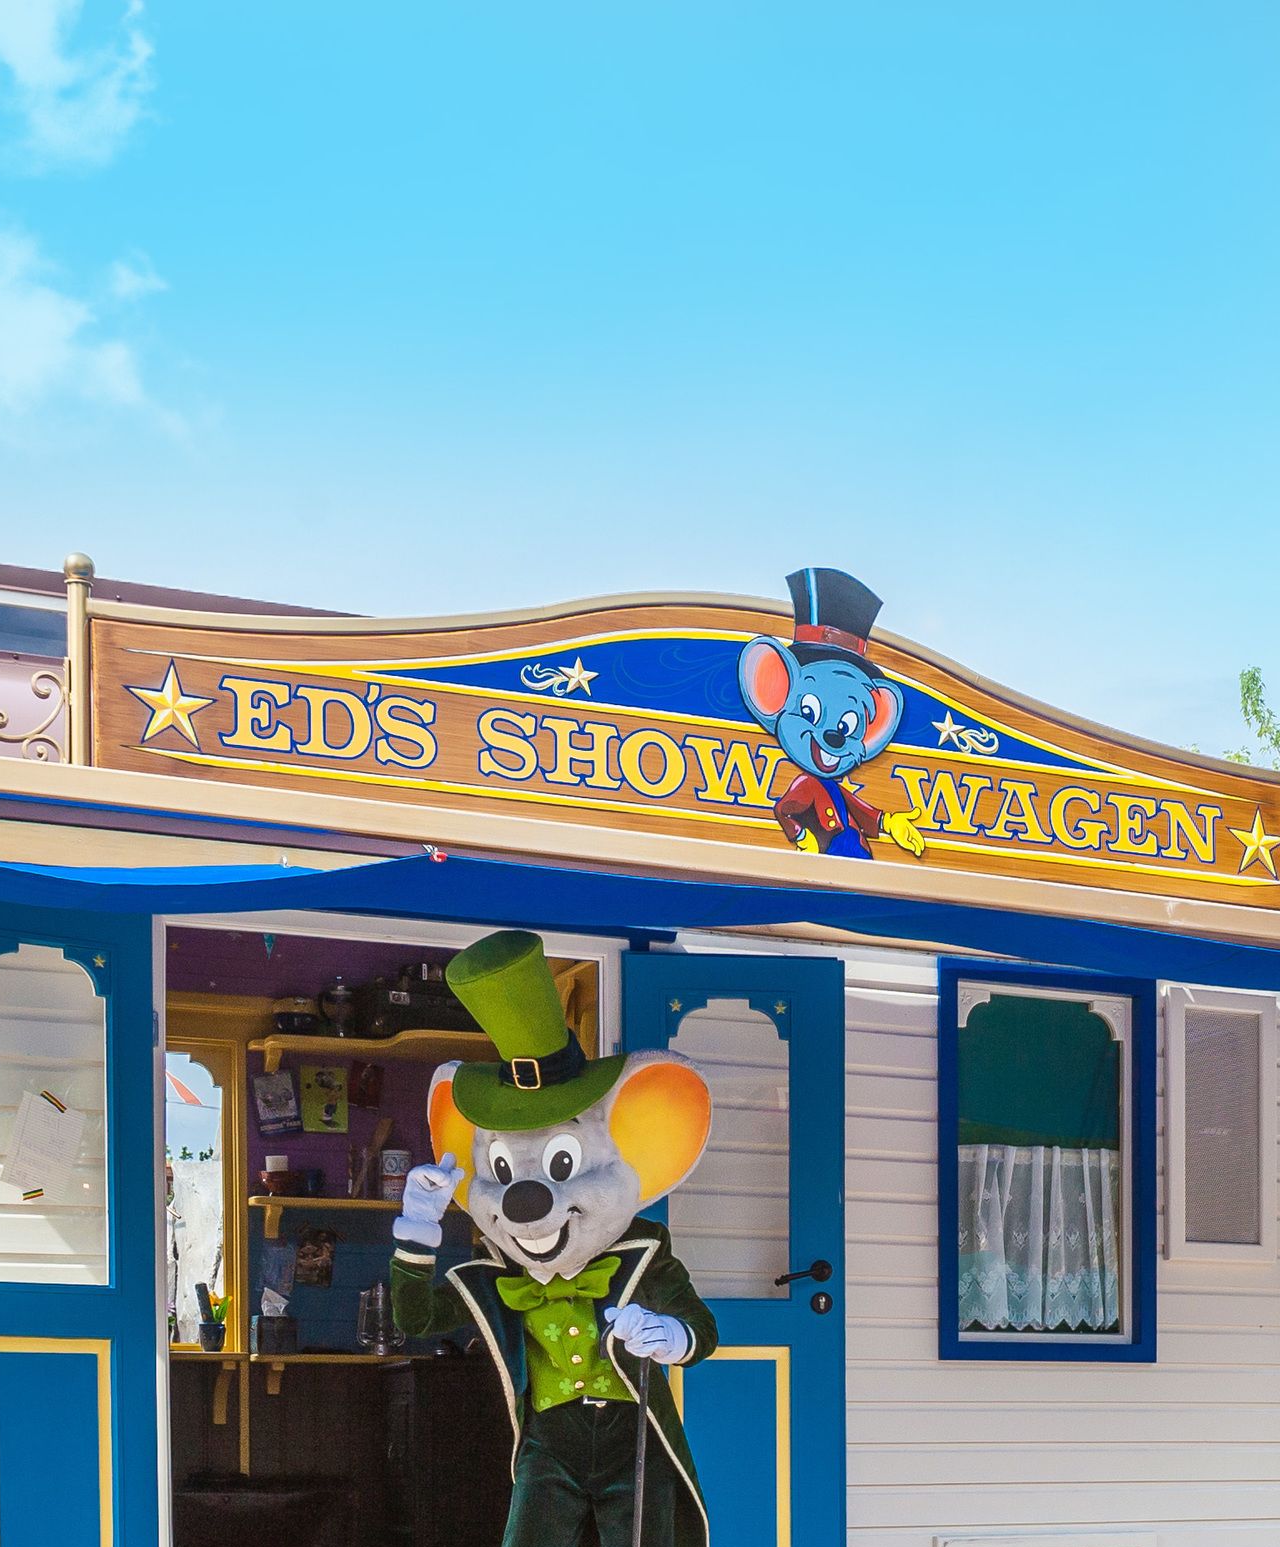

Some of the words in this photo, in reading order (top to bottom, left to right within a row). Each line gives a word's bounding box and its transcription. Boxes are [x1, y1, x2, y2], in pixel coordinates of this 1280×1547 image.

[218, 676, 437, 769] ED'S
[478, 706, 792, 808] SHOW
[892, 764, 1223, 864] WAGEN
